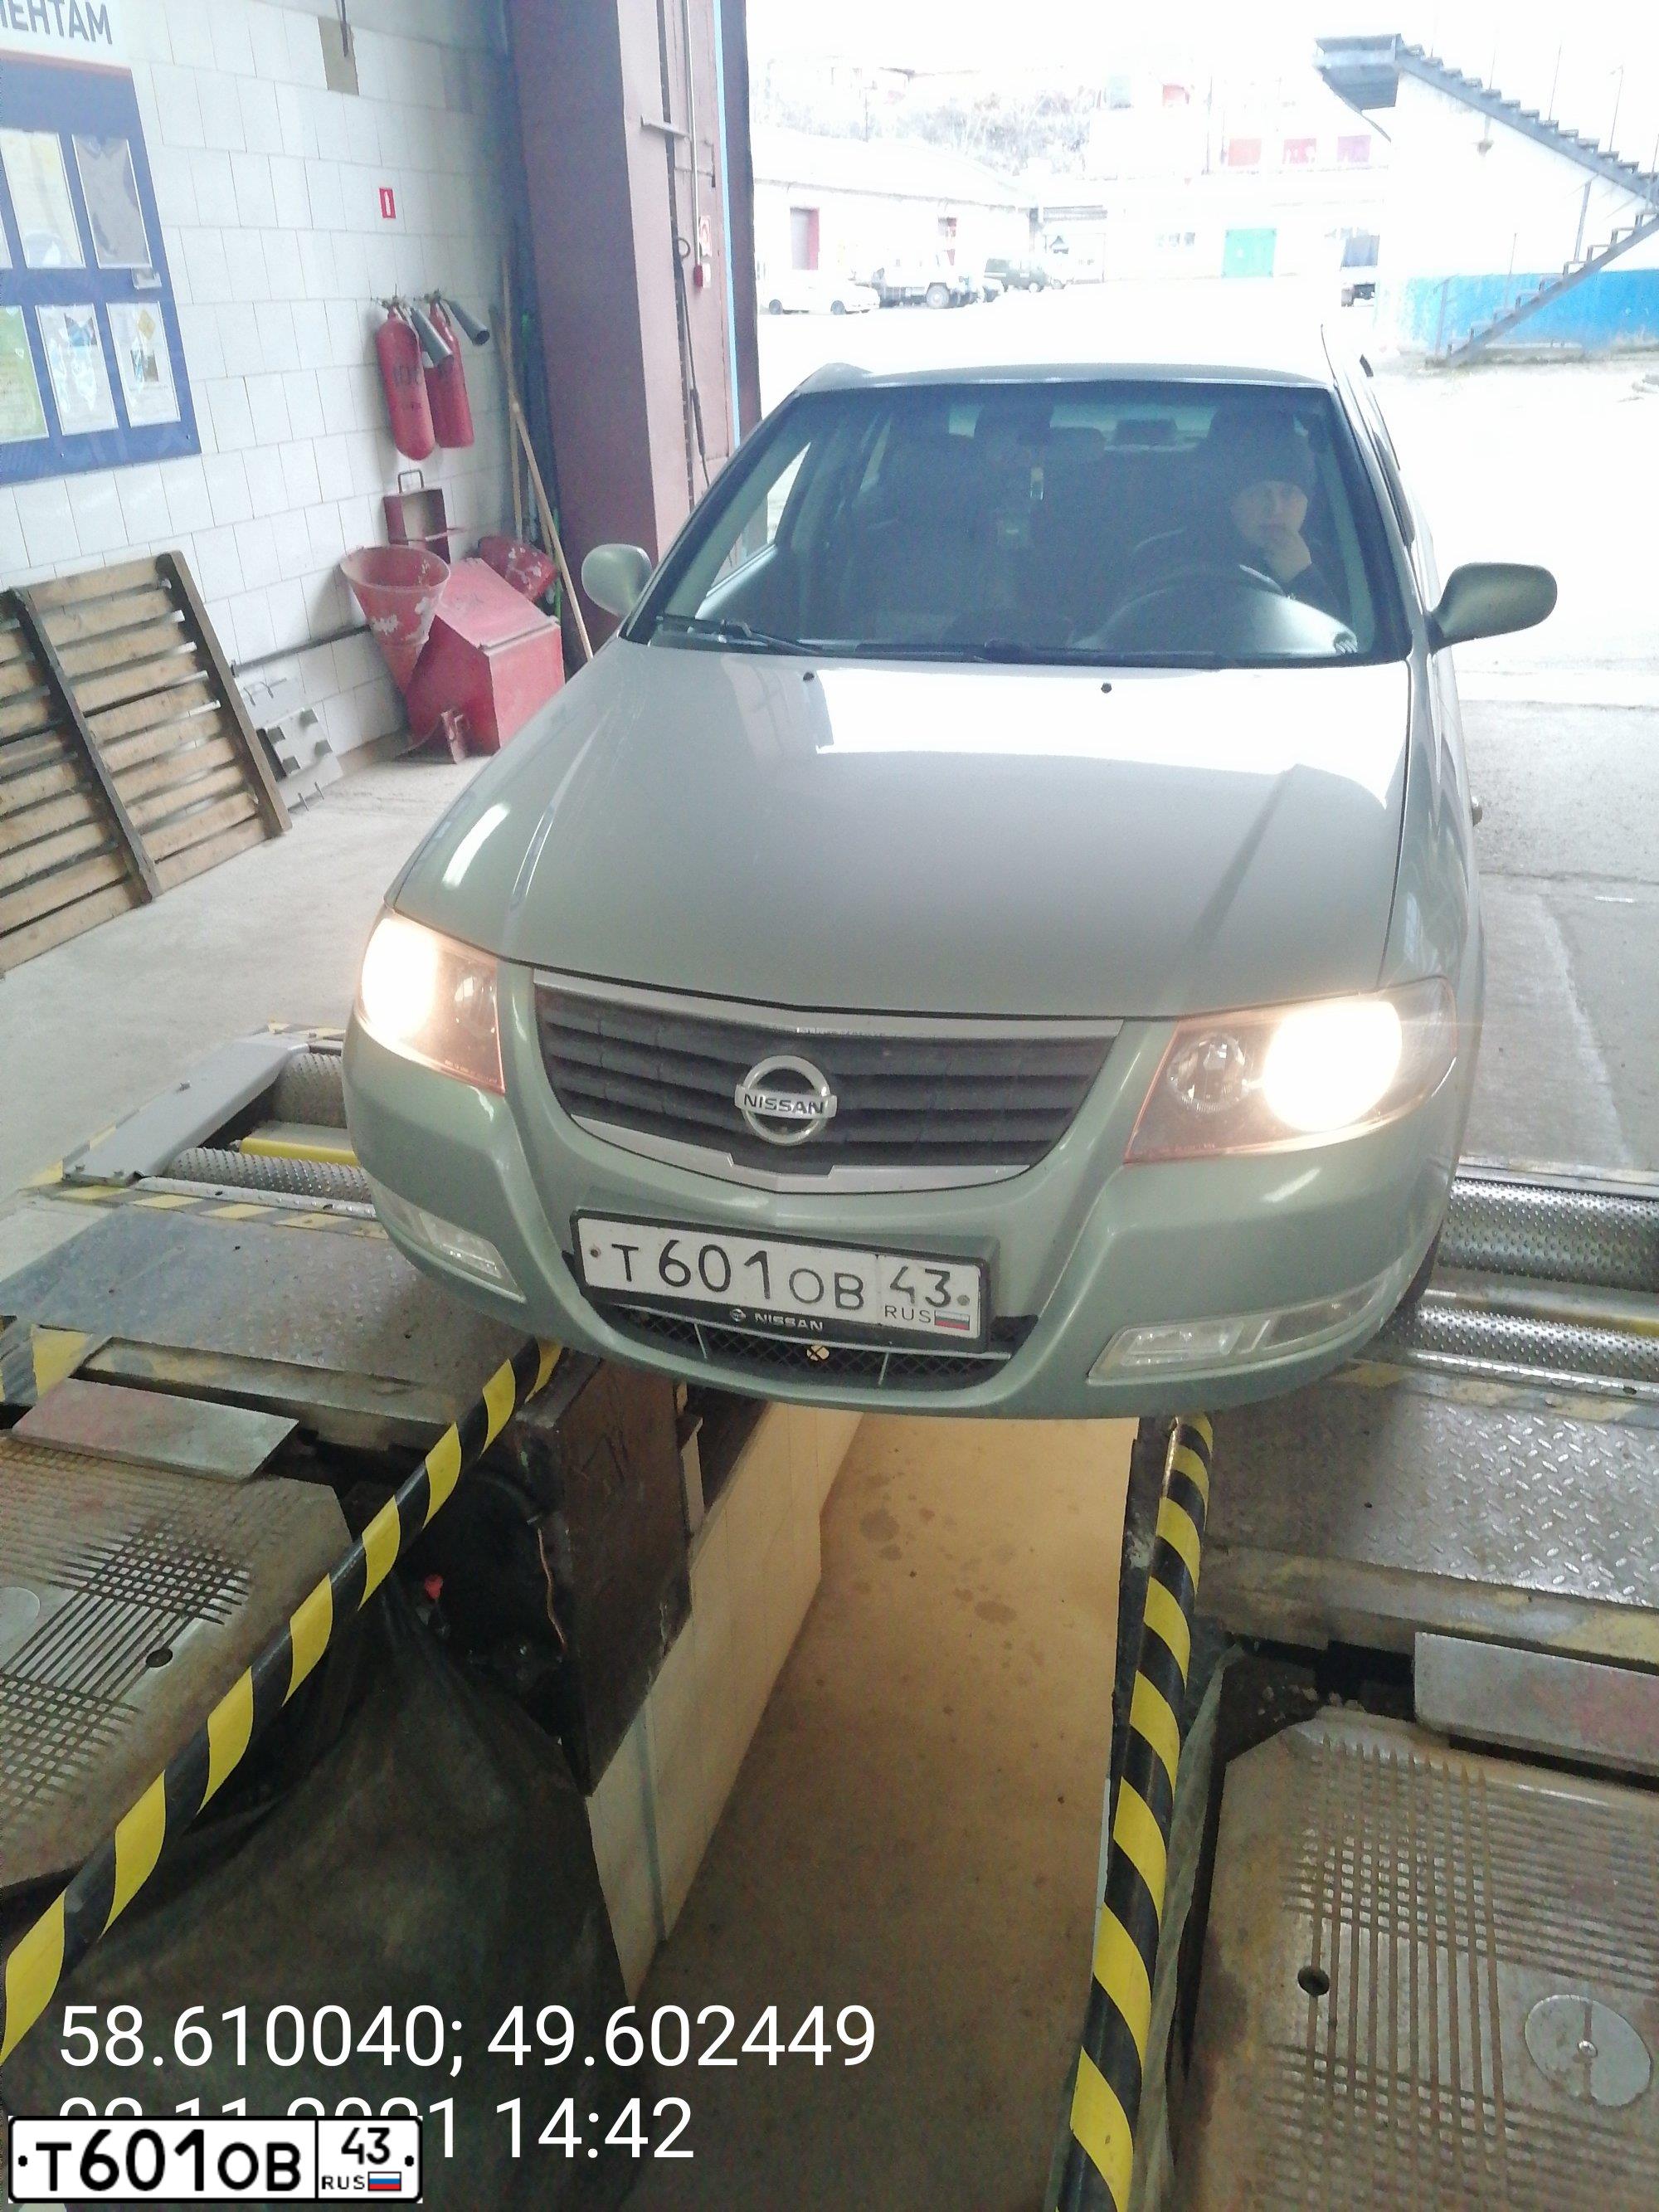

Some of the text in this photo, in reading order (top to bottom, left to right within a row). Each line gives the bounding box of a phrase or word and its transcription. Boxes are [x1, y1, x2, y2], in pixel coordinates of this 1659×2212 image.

[0, 0, 113, 45] ЕНТАМ
[742, 1092, 825, 1116] NISSAN
[889, 1265, 952, 1309] 43
[753, 1311, 825, 1331] NISSAN
[883, 1304, 932, 1324] RUS
